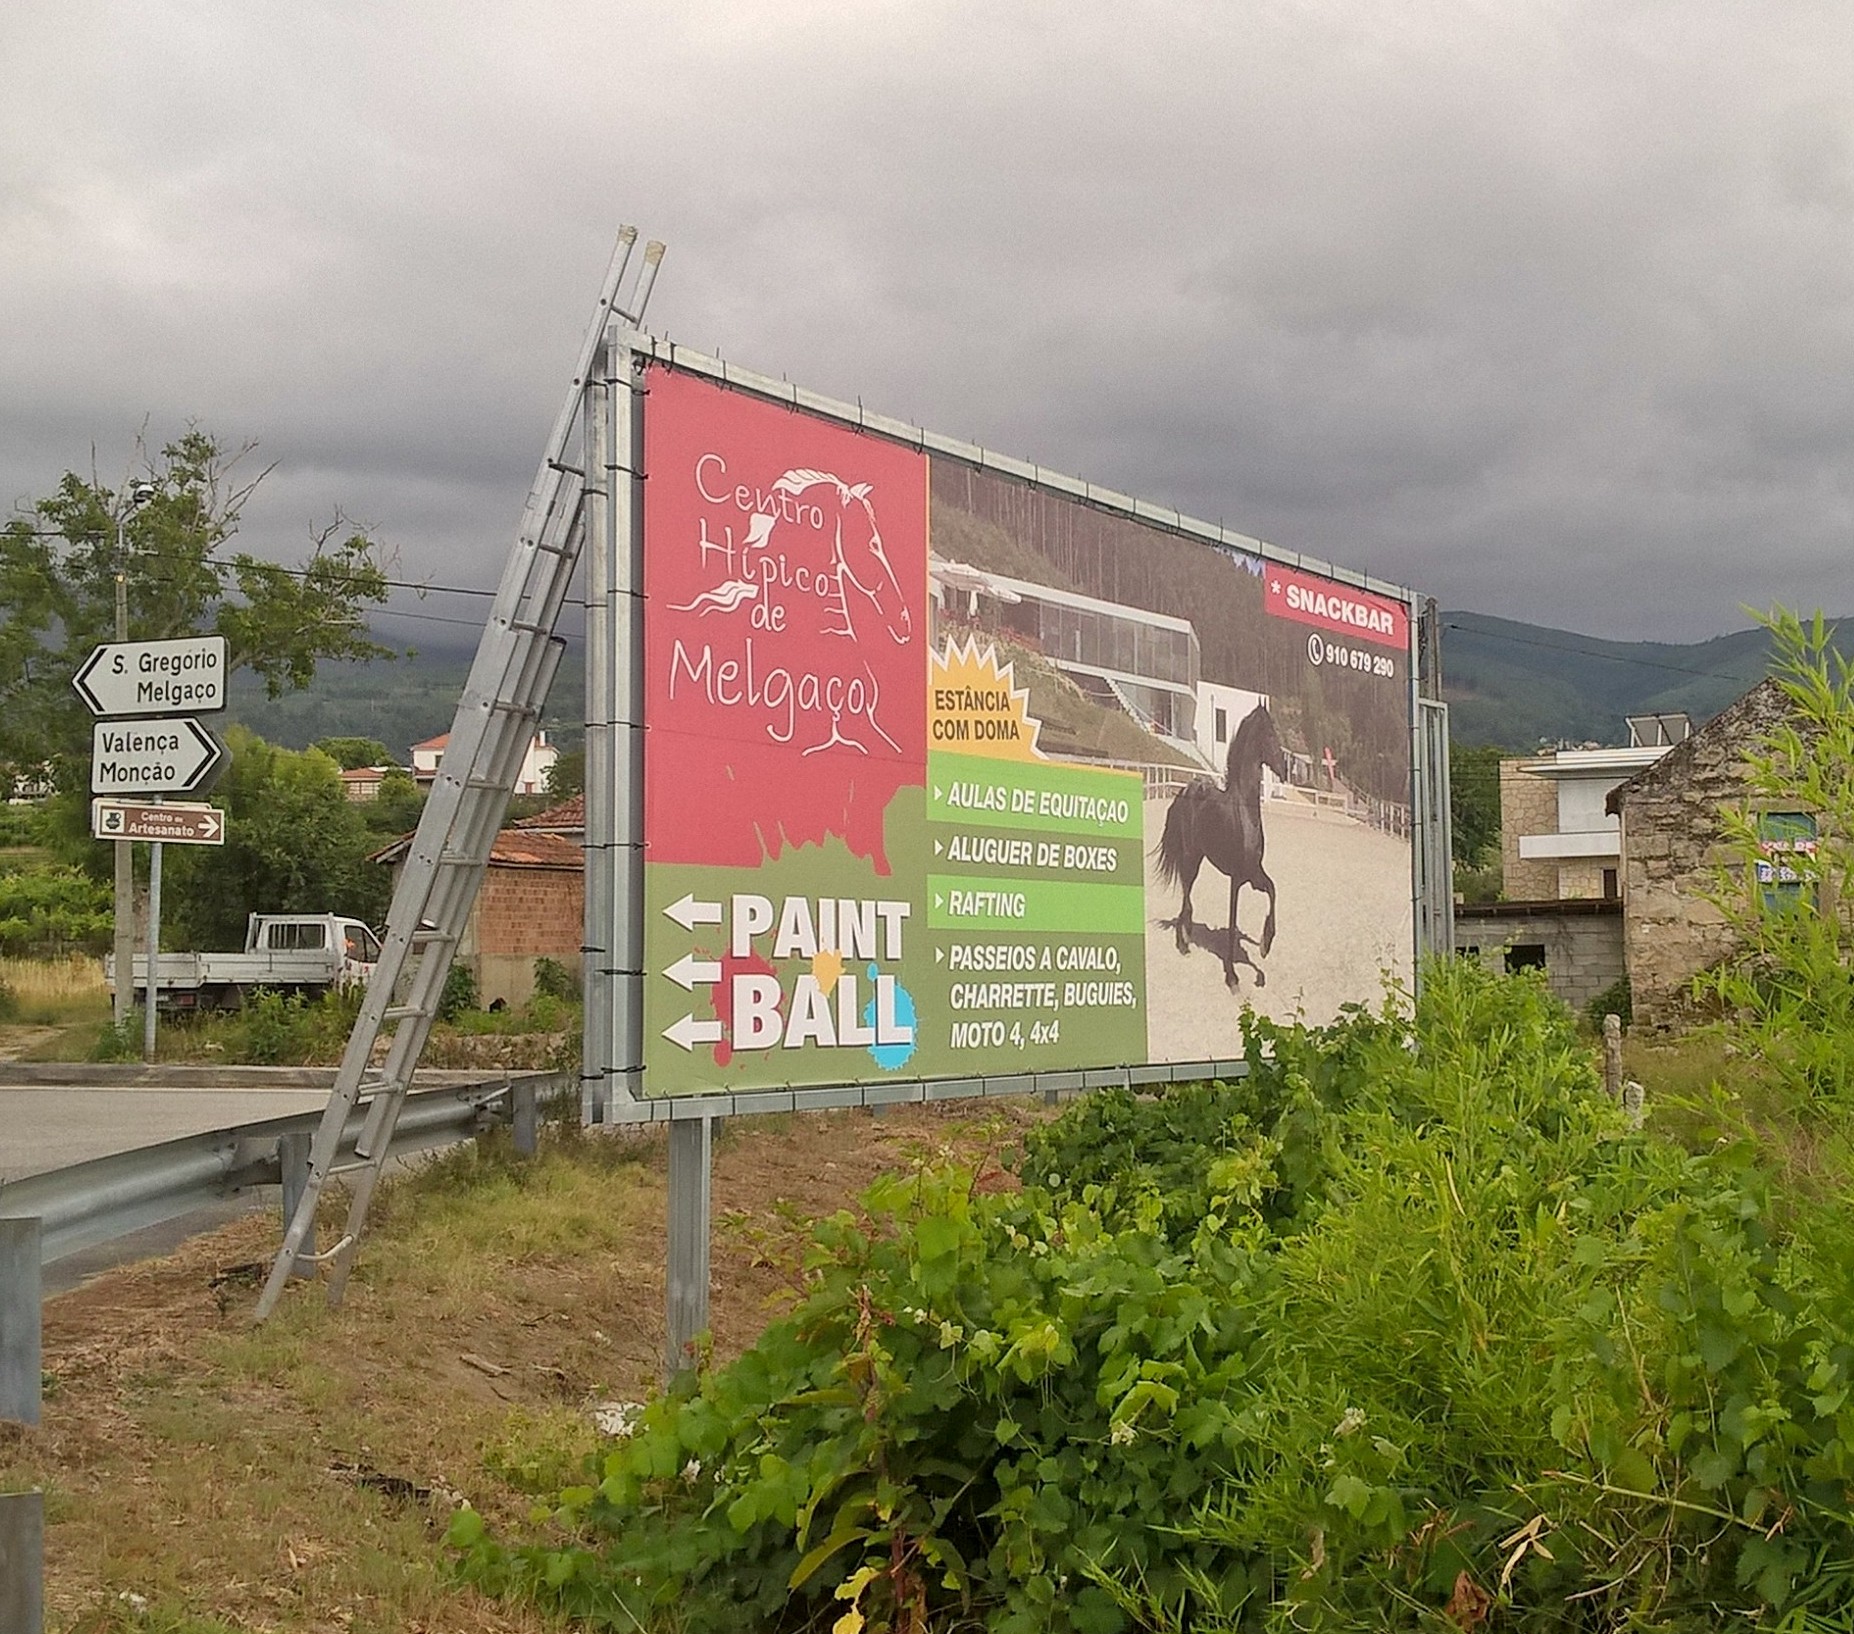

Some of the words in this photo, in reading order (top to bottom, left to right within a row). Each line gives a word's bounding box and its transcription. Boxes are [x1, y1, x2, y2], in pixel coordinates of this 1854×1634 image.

[696, 453, 823, 529] Centro
[750, 602, 787, 632] de
[1286, 584, 1394, 635] SNACKBAR
[112, 654, 128, 674] S.
[138, 648, 217, 676] Gregório
[1326, 644, 1348, 667] 910
[1350, 651, 1371, 673] 679
[1373, 656, 1394, 679] 290
[137, 682, 216, 706] Melgaço
[669, 637, 865, 742] Melgaço
[935, 685, 1010, 711] ESTÂNCIA
[102, 731, 179, 755] Valença
[933, 719, 969, 740] COM
[974, 719, 1020, 740] DOMA
[100, 761, 175, 785] Monção
[947, 781, 1007, 811] AULAS
[1011, 788, 1034, 814] DE
[128, 822, 195, 837] Artesanato
[141, 811, 173, 822] Centro
[947, 836, 1032, 866] ALUGUER
[1037, 842, 1060, 867] DE
[1063, 844, 1117, 872] BOXES
[948, 890, 1026, 918] RAFTING
[731, 893, 912, 960] PAINT
[949, 945, 1036, 971] PASSEIOS
[1039, 945, 1052, 970] A
[1056, 946, 1121, 975] CAVALO,
[731, 973, 914, 1051] BALL
[950, 983, 1059, 1012] CHARRETTE,
[950, 1021, 1005, 1049] MOTO
[1009, 1021, 1025, 1050] 4,
[1030, 1020, 1060, 1044] 4x4
